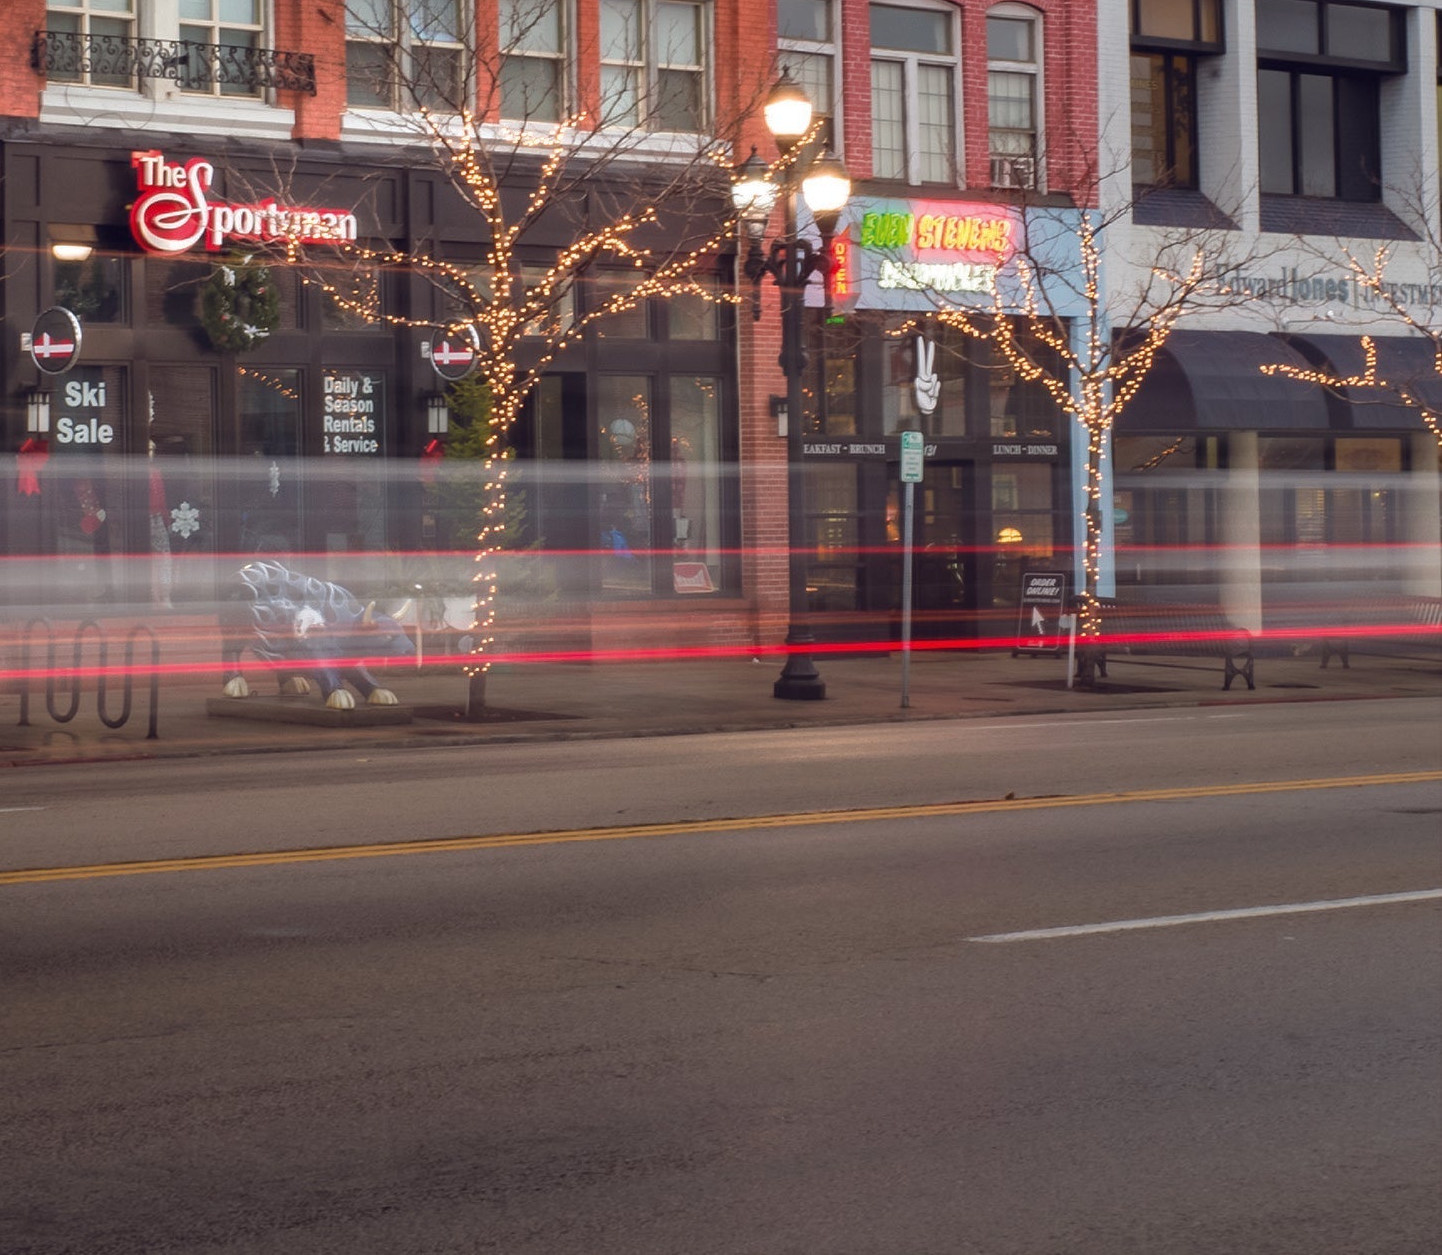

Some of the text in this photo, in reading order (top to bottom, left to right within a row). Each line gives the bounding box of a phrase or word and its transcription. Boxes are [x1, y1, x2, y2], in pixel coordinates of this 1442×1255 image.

[141, 155, 187, 187] The
[137, 162, 357, 251] Sportsman
[1291, 267, 1349, 302] Jones
[65, 381, 106, 407] Ski
[324, 377, 373, 397] Daily &
[324, 396, 373, 413] Season
[57, 417, 114, 444] Sale
[323, 415, 375, 433] Rentals
[333, 436, 378, 453] Service
[850, 444, 886, 455] BRUNCH
[993, 445, 1021, 455] LUNCH
[1028, 445, 1058, 455] DINNER
[1026, 587, 1060, 596] ONLINE!
[1030, 578, 1057, 587] ORDER
